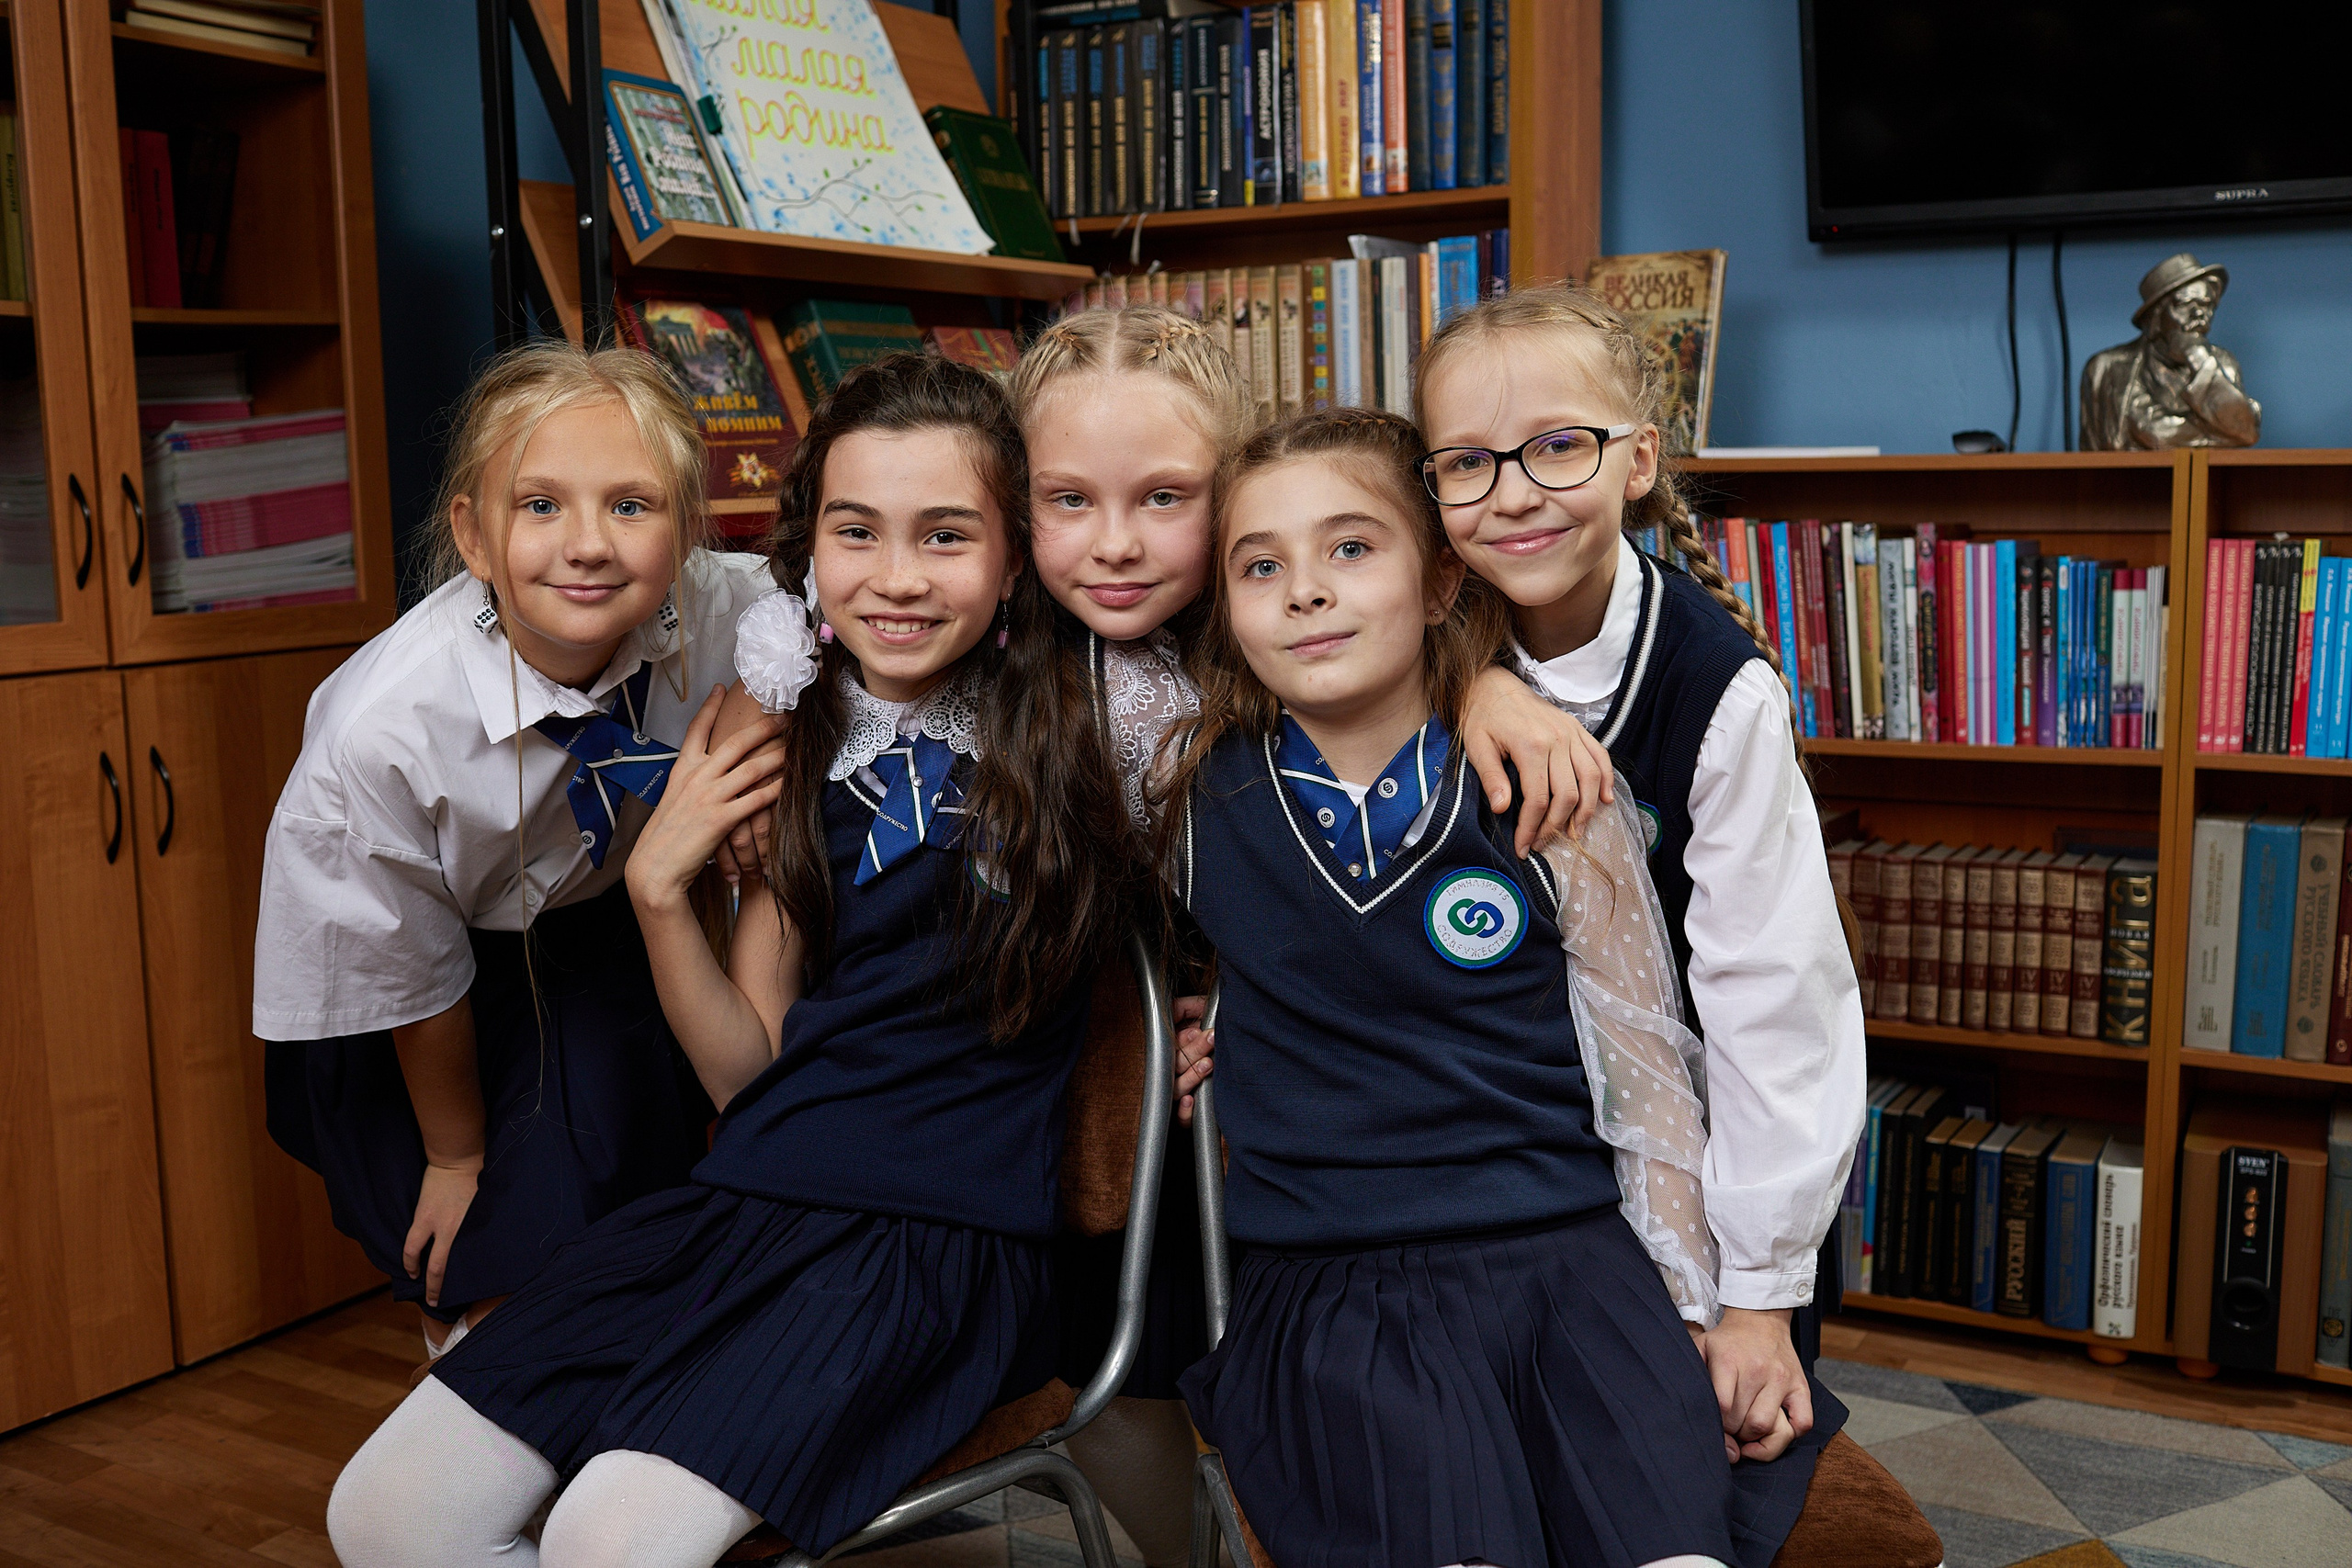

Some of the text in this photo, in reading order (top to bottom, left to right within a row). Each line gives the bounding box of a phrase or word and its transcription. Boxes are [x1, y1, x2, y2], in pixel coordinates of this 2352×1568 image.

[731, 36, 875, 98] малая
[1221, 76, 1230, 95] ДЛЯ
[1258, 49, 1271, 140] АСТРОНОМИЯ
[735, 89, 895, 160] родина
[1284, 73, 1295, 173] КОСМОНАВТИКА
[1604, 271, 1690, 293] ВЕЛИКАЯ
[1606, 287, 1694, 310] РОССИЯ
[1886, 560, 1900, 603] МИФЫ
[1888, 608, 1902, 666] НАРОДОВ
[876, 810, 908, 832] СОДРУЖЕСТВО
[1446, 878, 1510, 902] ГИМНАЗИЯ 15
[1436, 923, 1513, 959] СОДРУЖЕСТВО
[2298, 886, 2317, 1002] РУССКОГО ЯЗЫКА
[2310, 883, 2331, 1009] УЧЕБНЫЙ СЛОВАРЬ
[2238, 1155, 2267, 1168] SVEN
[2005, 1217, 2027, 1302] РУССКИЙ
[2098, 1174, 2117, 1307] Орфоэпический словарь
[2112, 1224, 2125, 1309] русского языка
